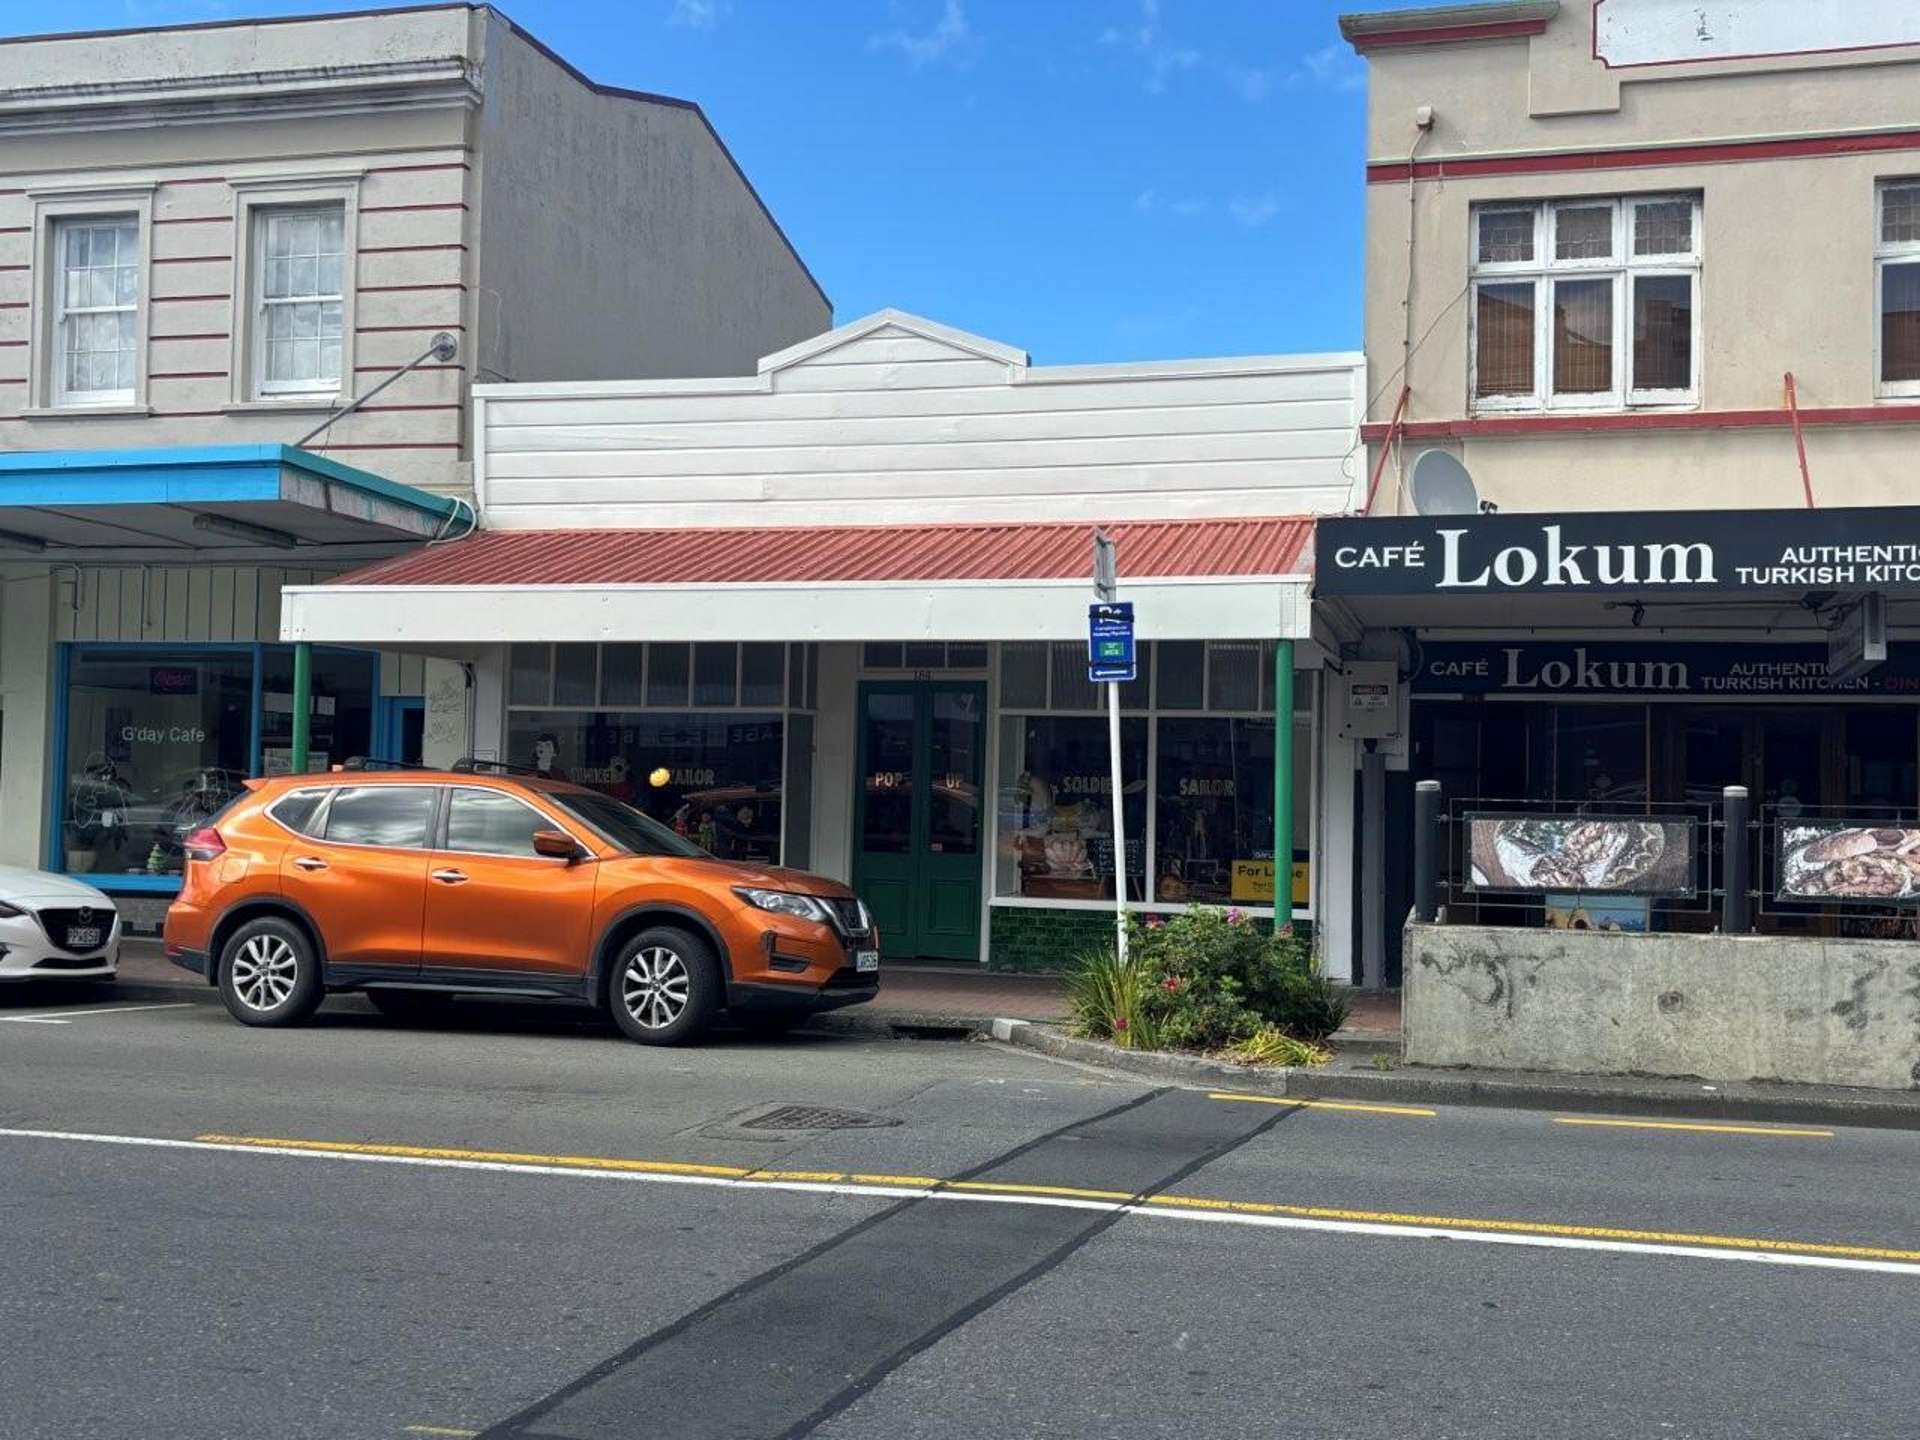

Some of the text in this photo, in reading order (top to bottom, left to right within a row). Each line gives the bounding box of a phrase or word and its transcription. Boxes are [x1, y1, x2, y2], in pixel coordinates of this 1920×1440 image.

[1335, 525, 1719, 587] CAFÉ Lokum
[1780, 545, 1920, 564] AUTHENTI
[1735, 566, 1855, 584] TURKISH
[1430, 648, 1691, 690] CAFÉ Lokum
[1701, 676, 1784, 690] TURKISH
[121, 726, 206, 744] G'day Cafe
[875, 772, 903, 787] POP
[1063, 776, 1113, 794] SOLDIE
[1238, 865, 1260, 877] For
